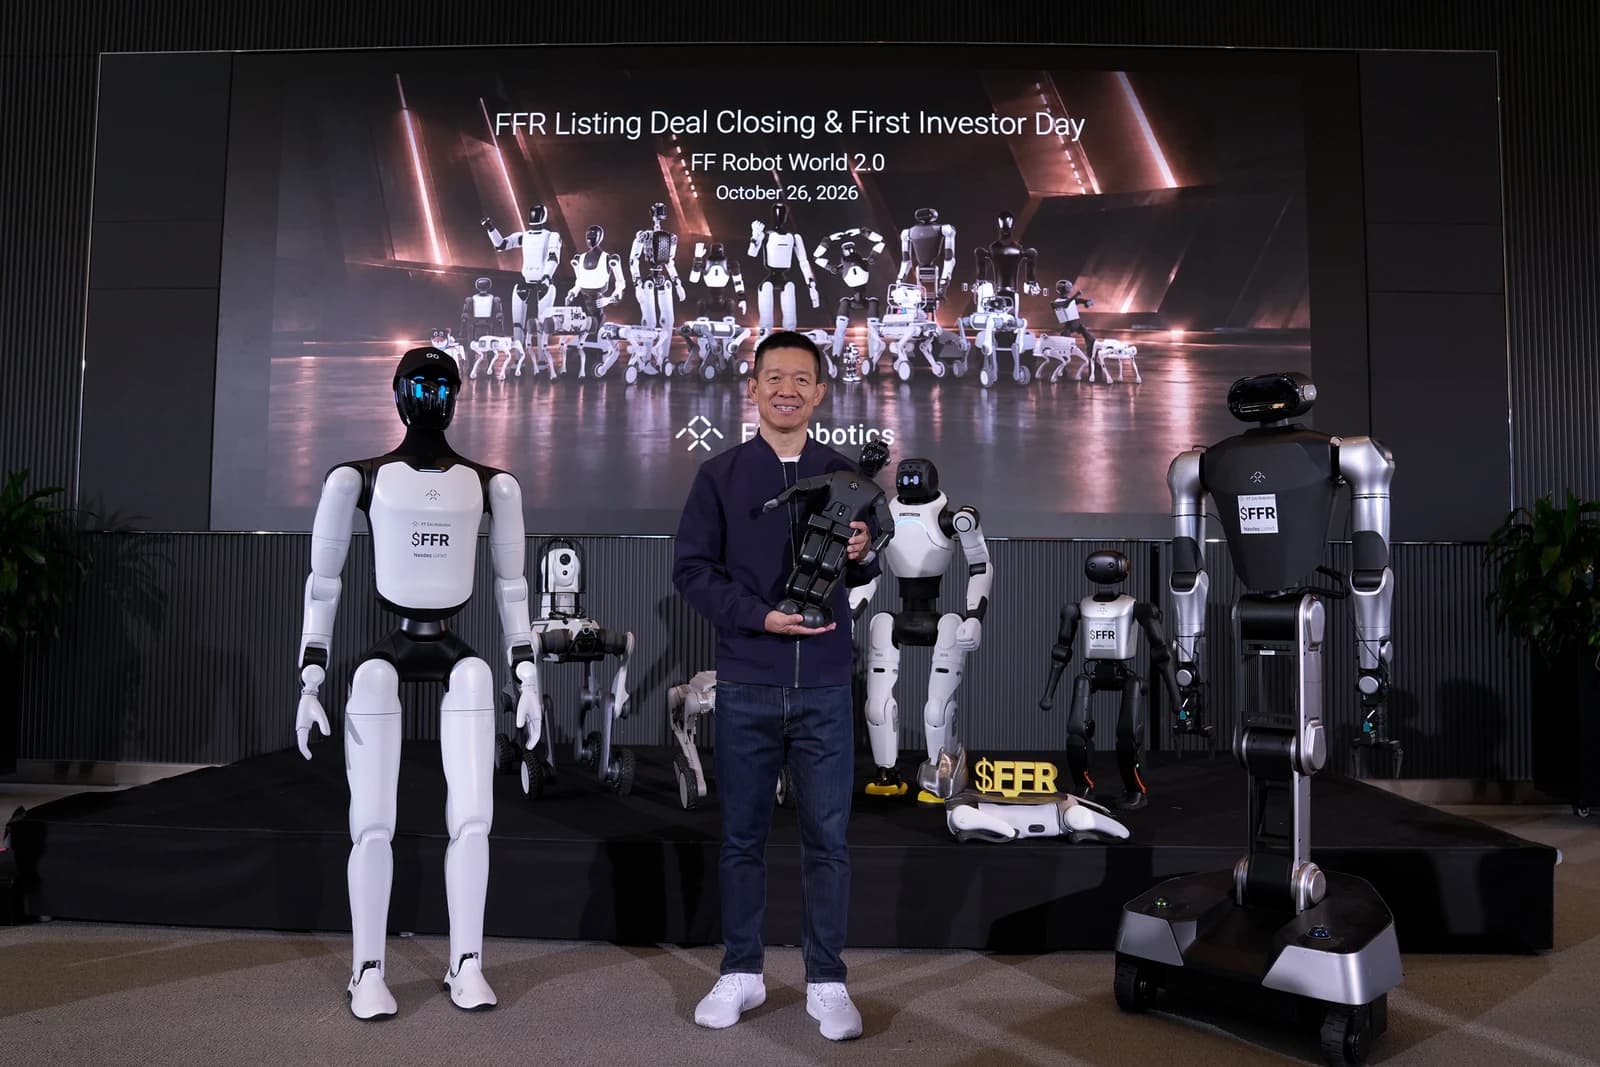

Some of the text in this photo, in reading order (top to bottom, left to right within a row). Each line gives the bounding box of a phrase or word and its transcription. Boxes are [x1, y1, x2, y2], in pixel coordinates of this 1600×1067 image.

[495, 109, 1086, 141] FFR Listing Deal Closing & First Investor Day
[691, 152, 885, 171] FF Robot World 2.0
[715, 184, 859, 202] October 26, 2026
[806, 422, 895, 445] botics
[1240, 506, 1275, 520] $FFR
[411, 531, 449, 547] $FFR
[1089, 629, 1115, 640] $FFR
[975, 757, 1058, 793] $FFR
